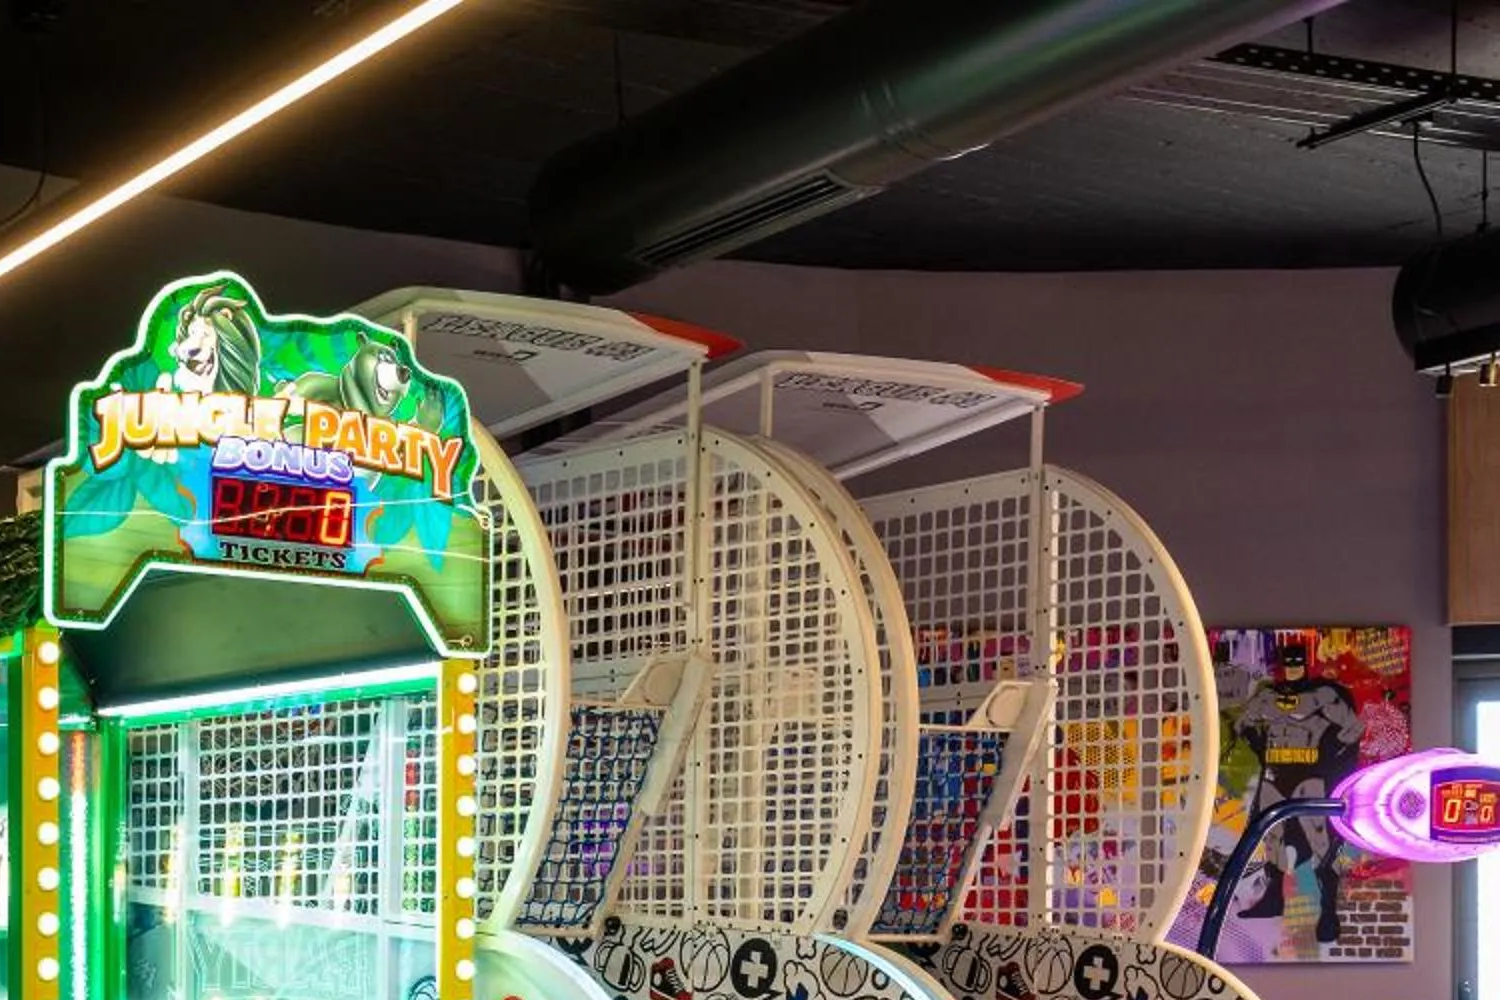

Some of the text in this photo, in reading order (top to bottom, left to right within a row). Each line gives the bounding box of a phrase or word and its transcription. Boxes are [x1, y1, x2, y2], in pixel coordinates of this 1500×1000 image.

[89, 388, 463, 501] JUNGLE PARTY
[211, 435, 354, 485] BONUS
[219, 541, 347, 570] TICKETS
